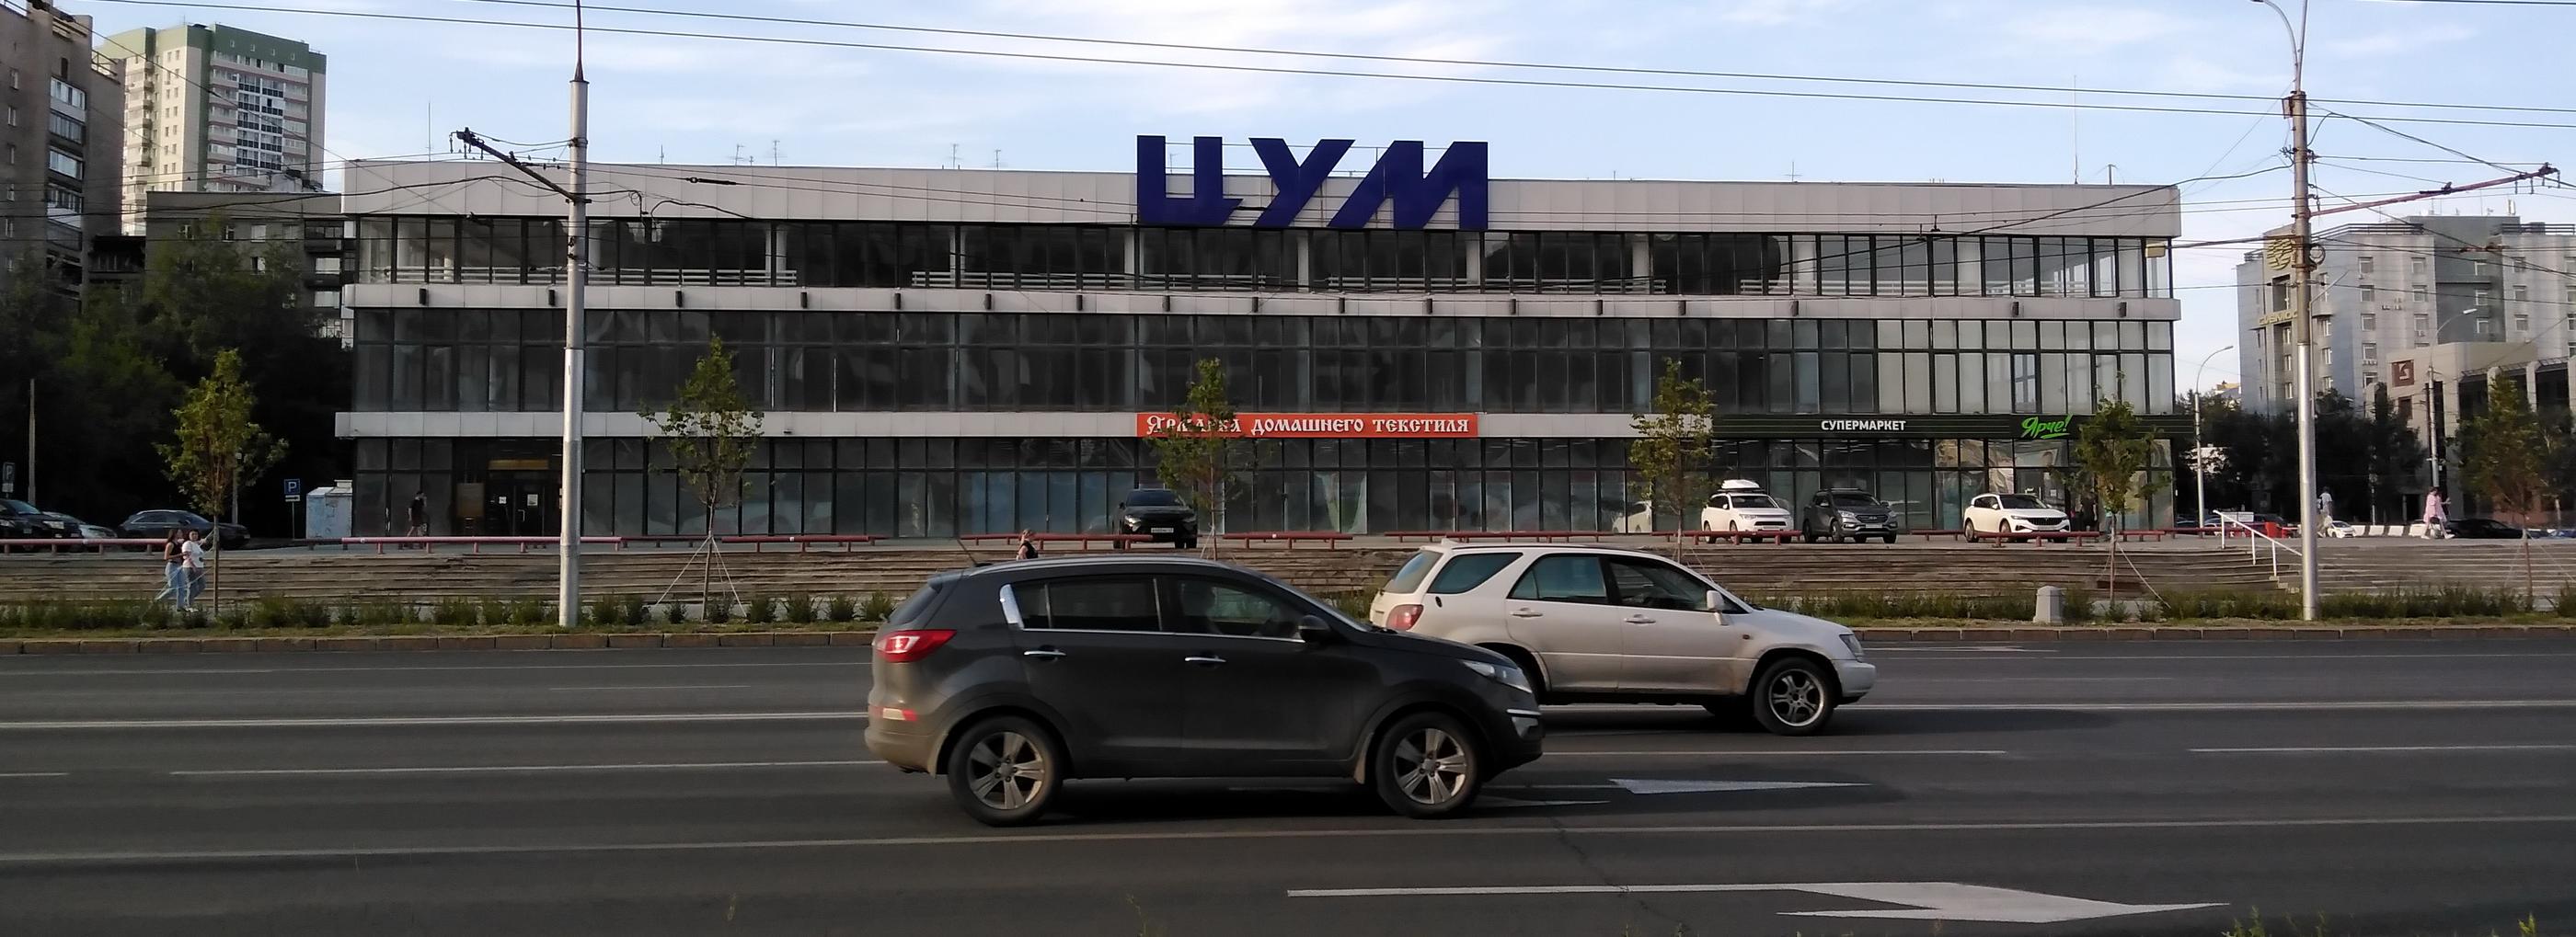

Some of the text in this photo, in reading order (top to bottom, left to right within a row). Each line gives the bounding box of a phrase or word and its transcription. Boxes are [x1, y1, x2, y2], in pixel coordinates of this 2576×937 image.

[1137, 135, 1489, 230] ЦУМ
[1821, 420, 1906, 431] СУПЕРМАРКЕТ
[2020, 412, 2074, 439] Ярче!
